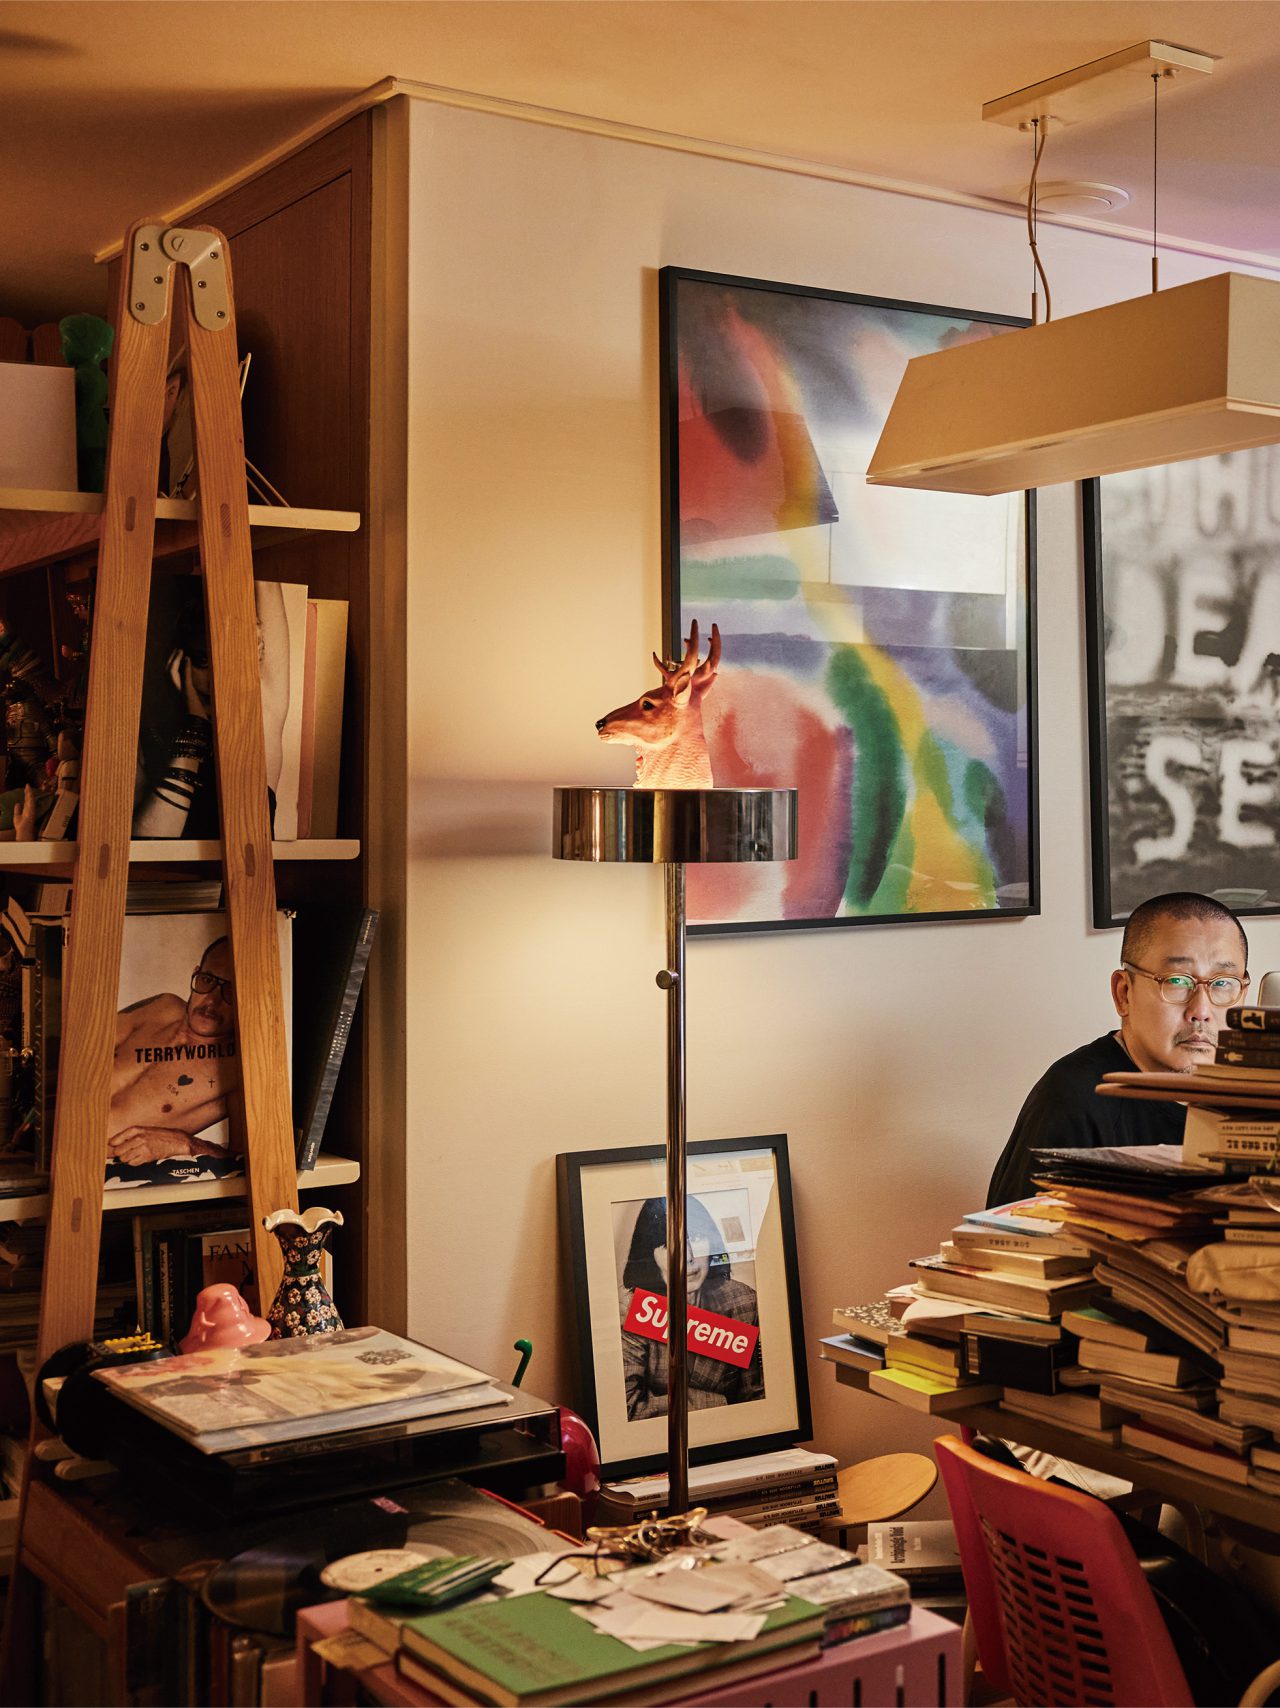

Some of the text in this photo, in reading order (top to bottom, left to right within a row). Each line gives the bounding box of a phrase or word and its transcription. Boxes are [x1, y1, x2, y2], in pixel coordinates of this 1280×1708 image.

[135, 1044, 236, 1063] TERRYWORLD
[172, 1167, 200, 1176] TASCHEN
[209, 1242, 250, 1261] FAN
[635, 1296, 749, 1354] Sureme
